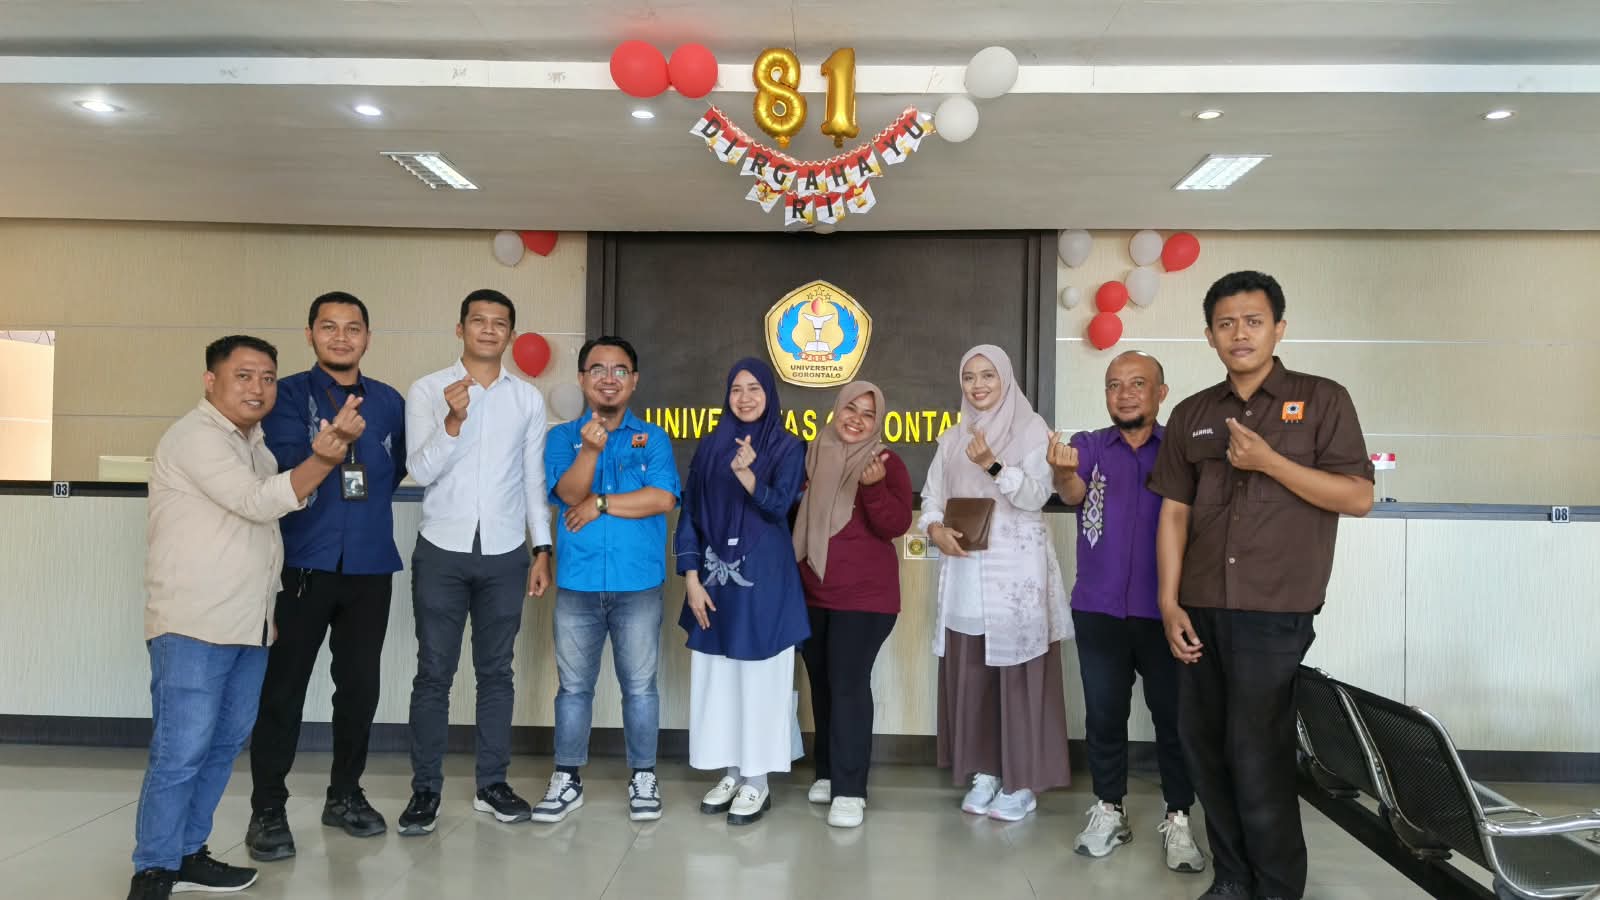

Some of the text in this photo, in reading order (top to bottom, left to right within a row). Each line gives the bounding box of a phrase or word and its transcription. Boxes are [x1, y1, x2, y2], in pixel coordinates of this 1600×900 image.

[753, 47, 861, 140] 81
[701, 116, 924, 191] DIRGAHAYU
[791, 197, 834, 219] RI
[790, 364, 844, 372] UNIVERSITAS
[792, 371, 841, 379] GORONTALO
[645, 407, 818, 442] UNIVEAS
[55, 483, 68, 496] 03
[1554, 508, 1568, 521] 08
